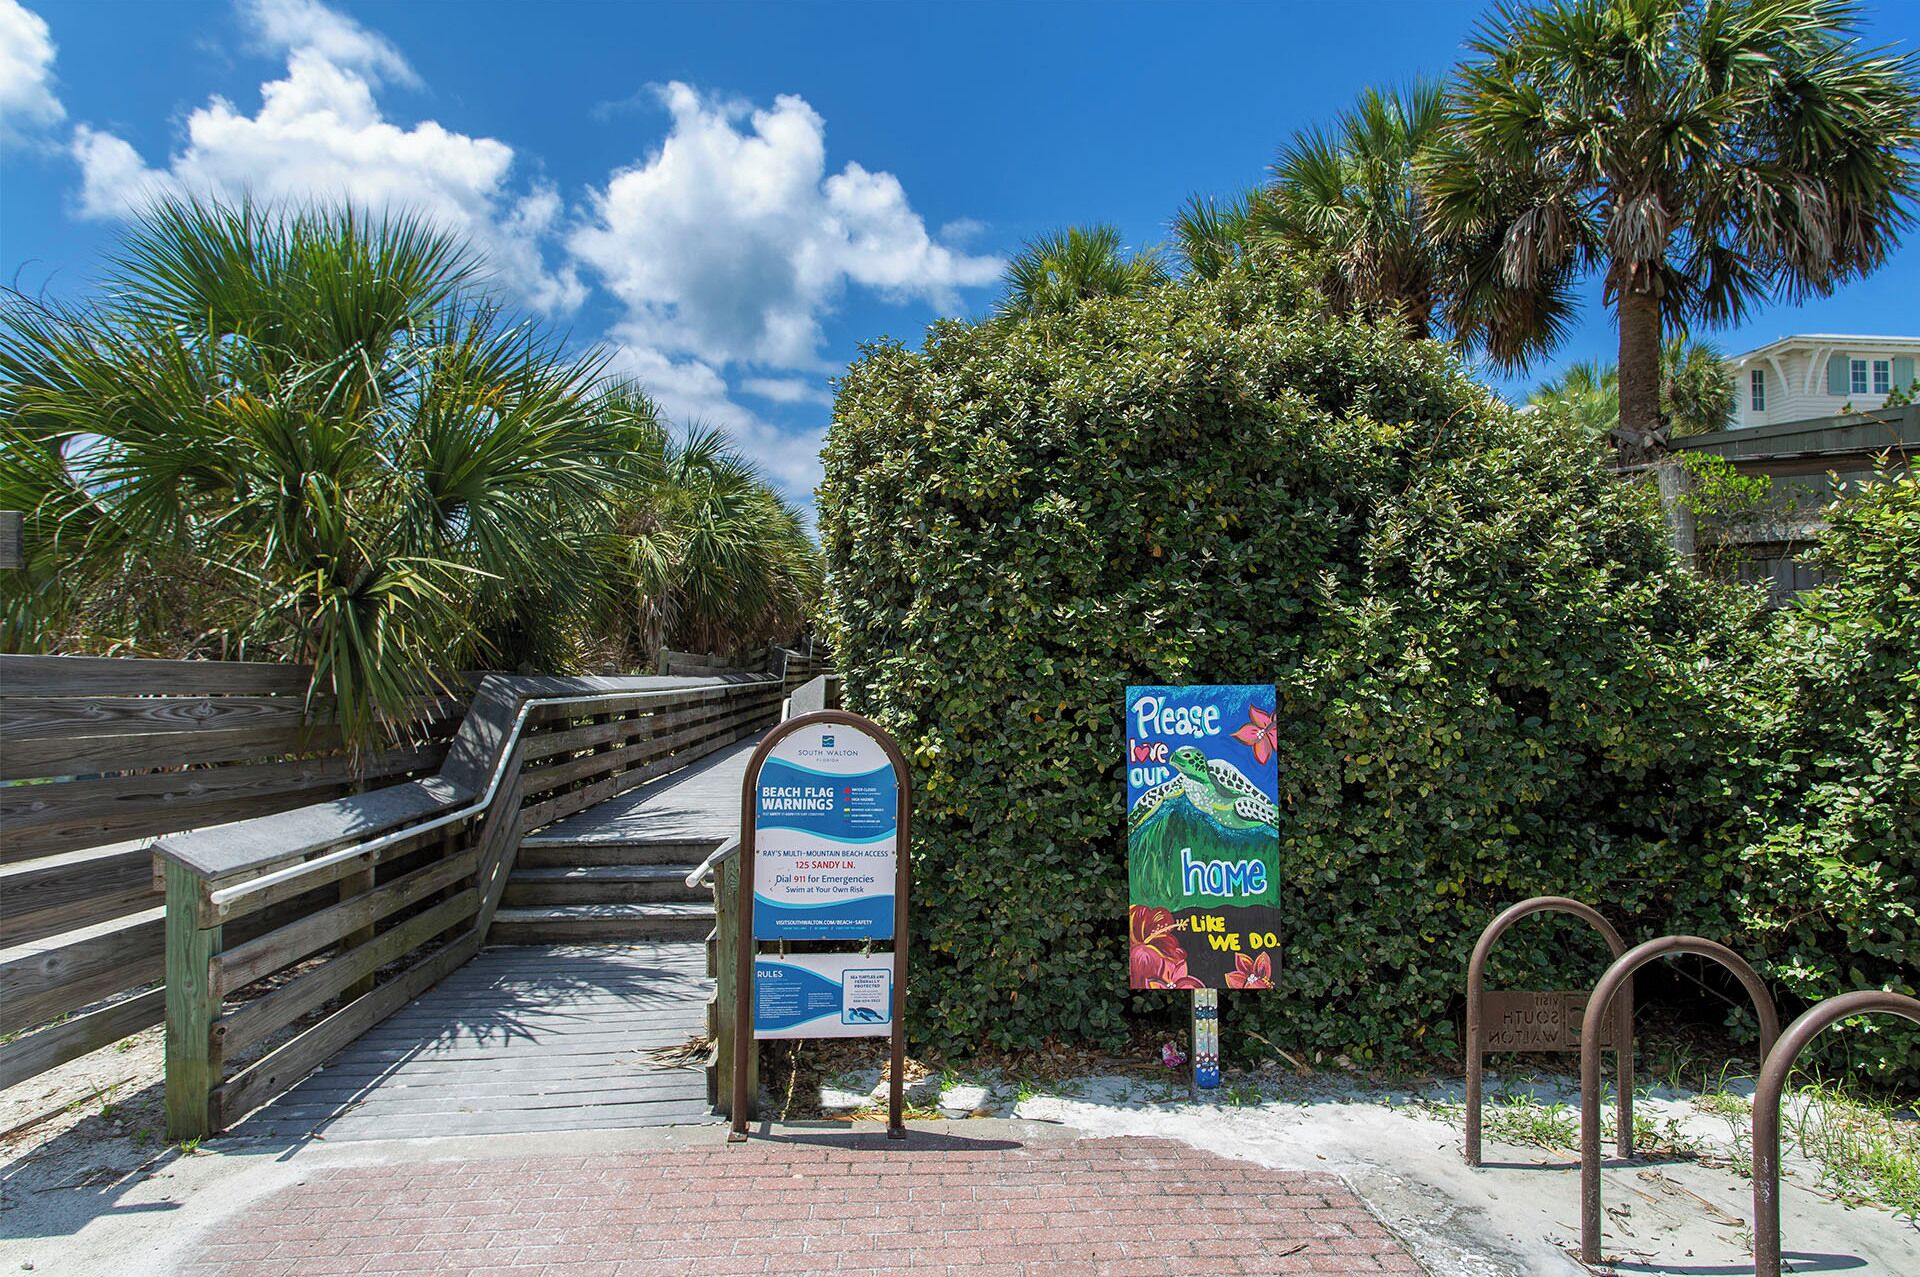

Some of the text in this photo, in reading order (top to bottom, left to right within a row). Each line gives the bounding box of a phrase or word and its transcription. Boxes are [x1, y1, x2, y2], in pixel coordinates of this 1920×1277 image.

[1131, 696, 1222, 739] Please
[1129, 766, 1170, 789] our
[762, 787, 834, 797] BEACH FLAG
[762, 798, 834, 810] WARNINGS
[795, 861, 856, 869] 125 SANDY LN.
[776, 874, 875, 885] Dial 911 for Emergencies
[1207, 933, 1241, 952] WE
[757, 970, 784, 978] RULES
